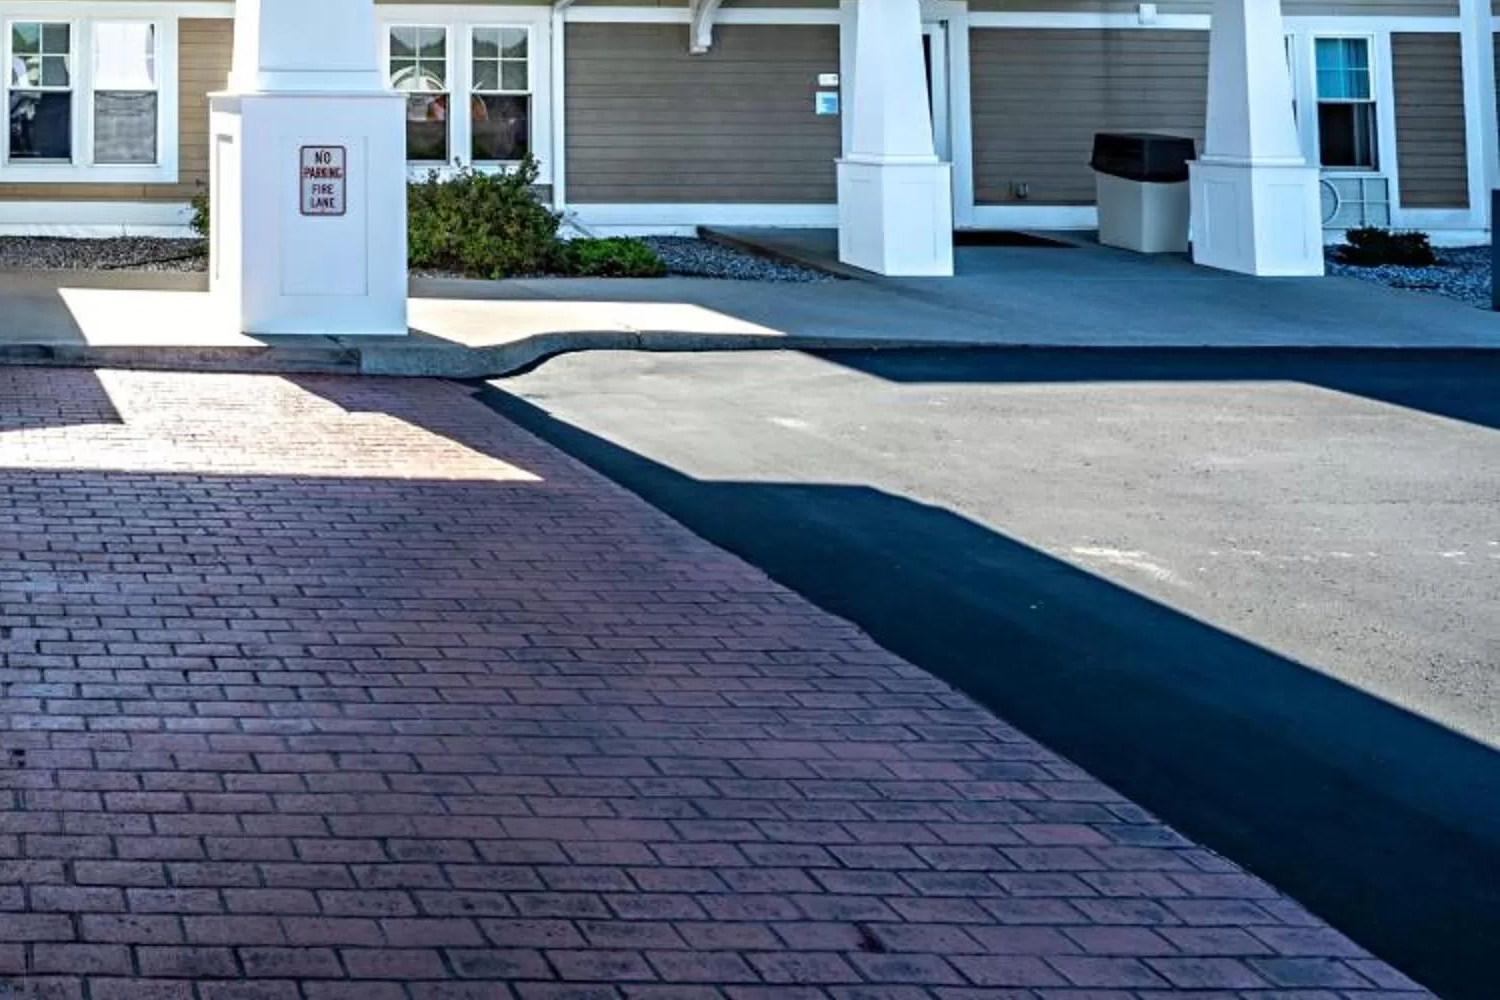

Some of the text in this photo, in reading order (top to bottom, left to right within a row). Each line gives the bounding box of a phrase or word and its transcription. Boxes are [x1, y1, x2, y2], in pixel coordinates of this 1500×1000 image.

[315, 151, 331, 165] NO
[312, 183, 334, 195] FIRE
[310, 197, 336, 209] LANE
